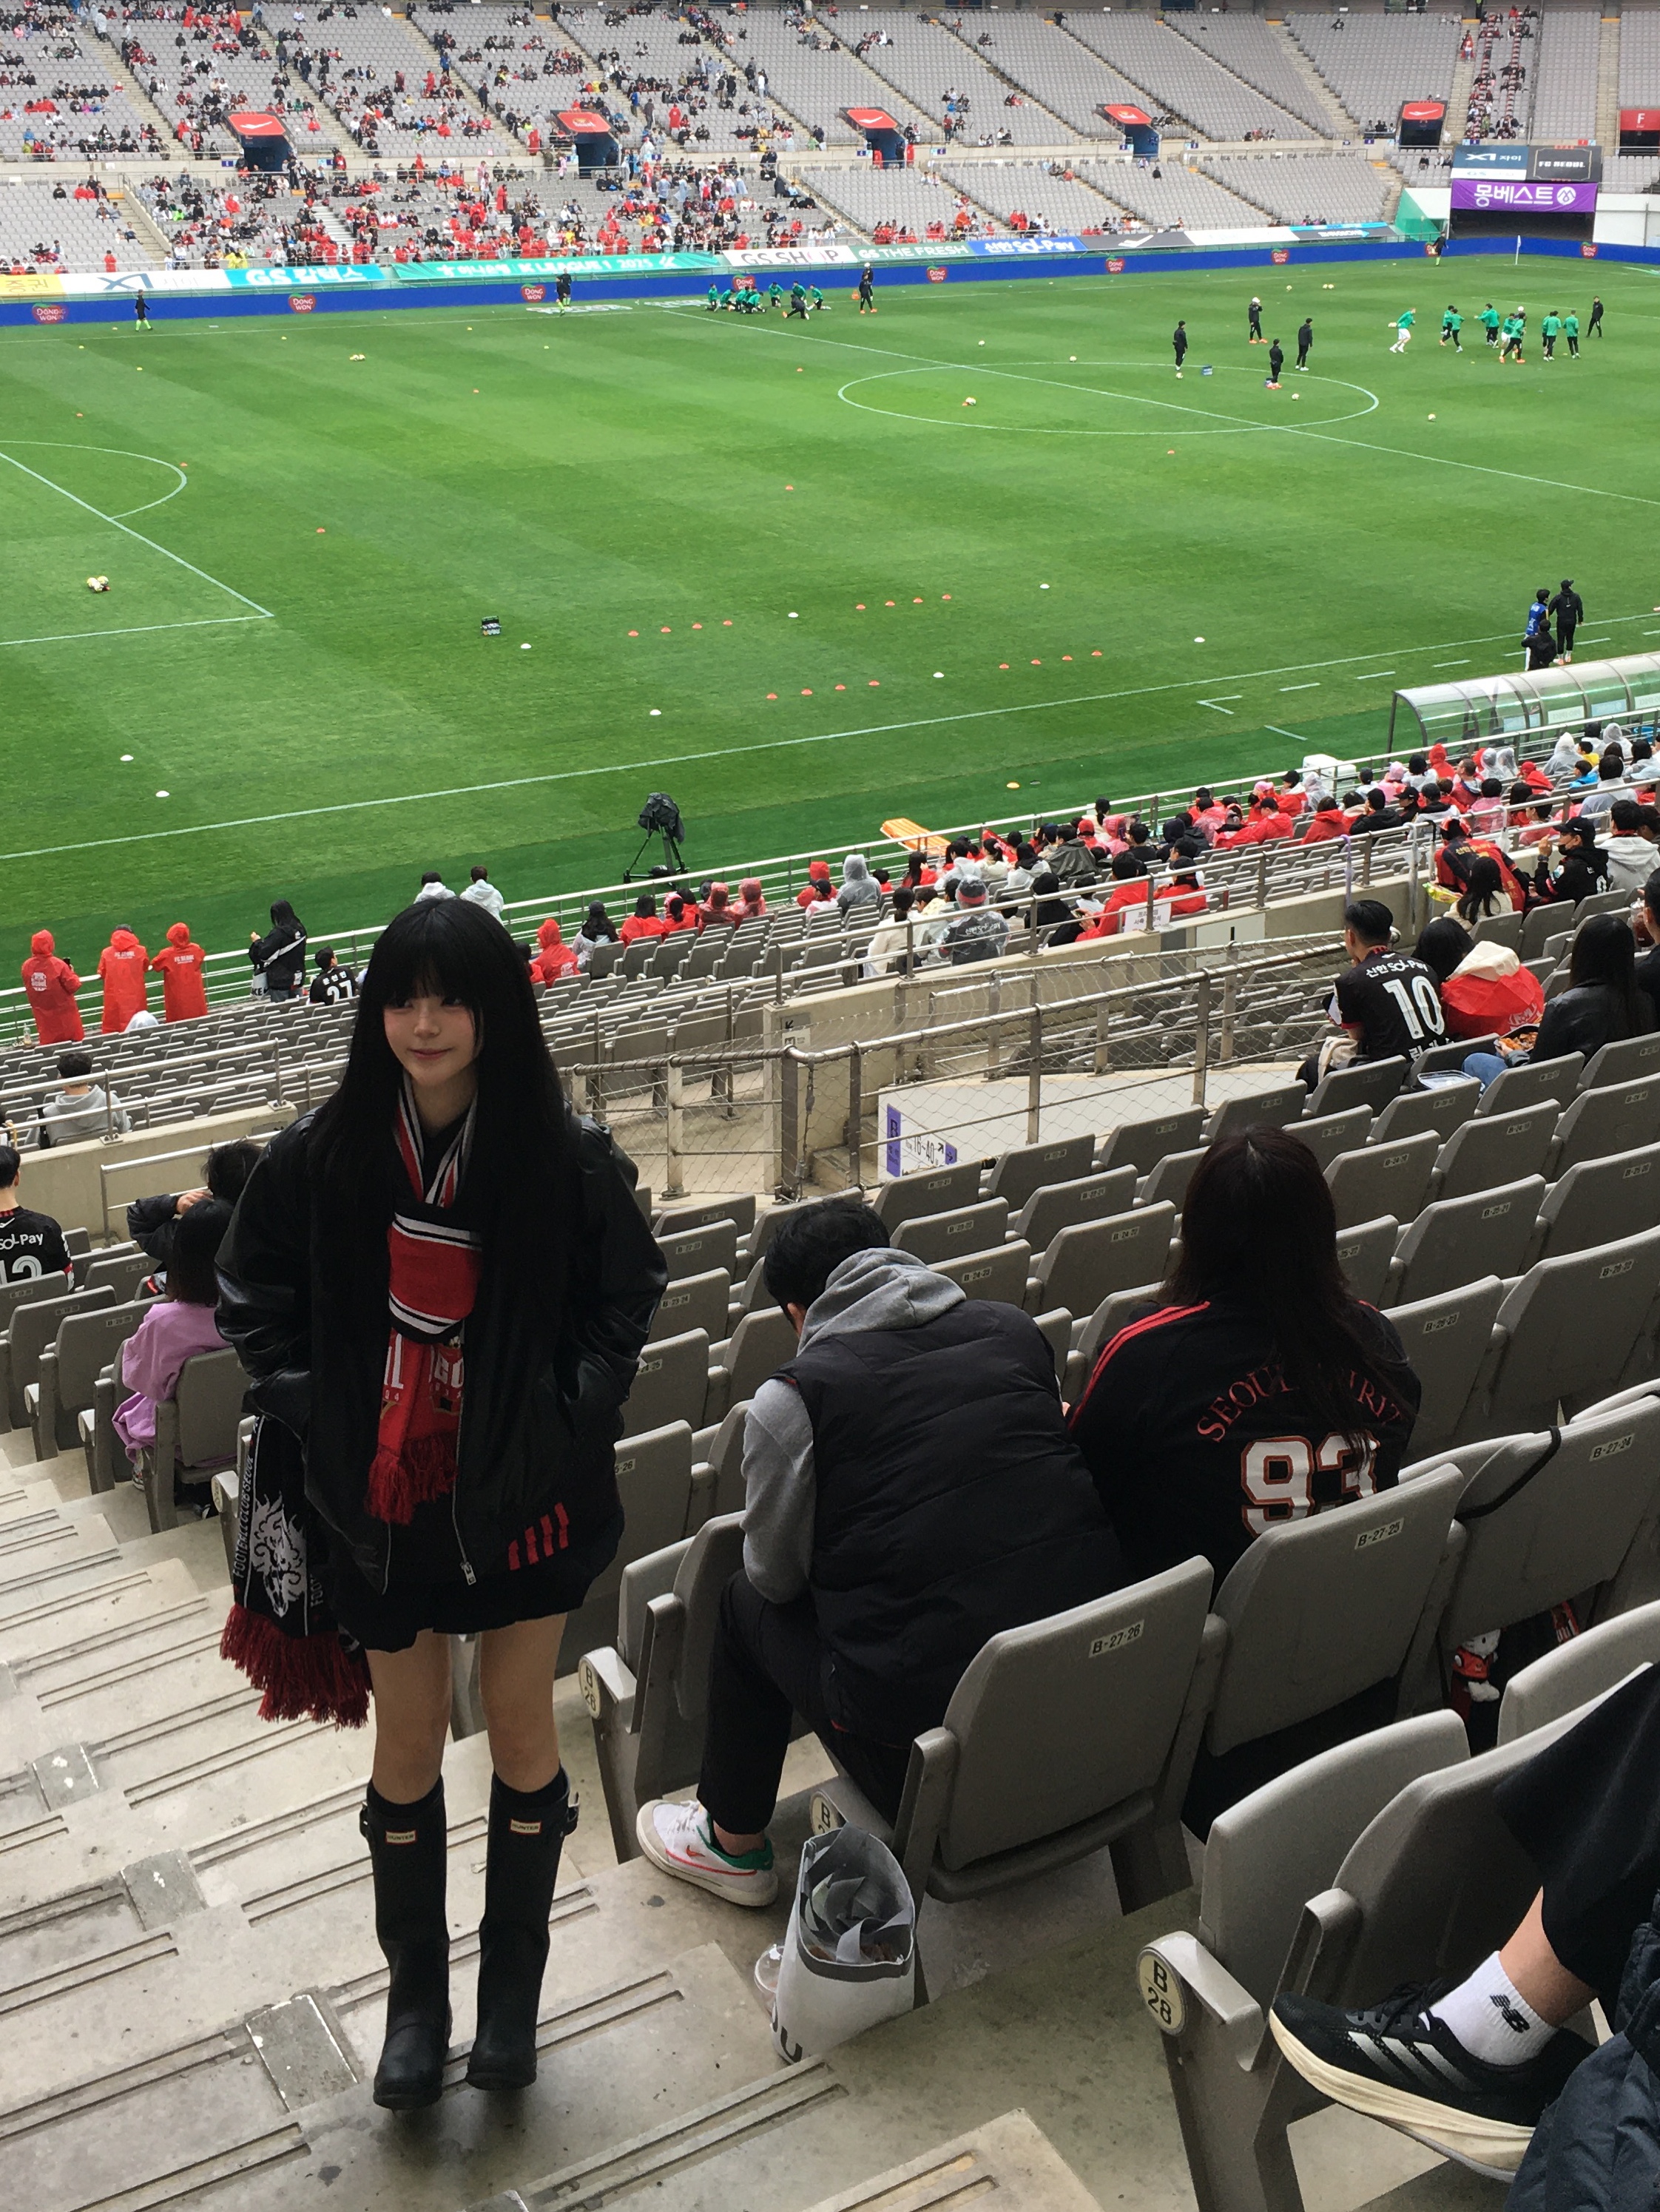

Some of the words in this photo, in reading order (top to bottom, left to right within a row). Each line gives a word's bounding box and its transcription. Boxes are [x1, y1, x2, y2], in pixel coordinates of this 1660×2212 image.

[1637, 112, 1645, 124] F
[1474, 184, 1553, 208] 몽베스트
[740, 252, 775, 266] GS
[775, 249, 840, 265] SHOP
[858, 249, 880, 260] GS
[879, 247, 914, 258] THE
[914, 245, 969, 257] FRESH
[5, 278, 49, 293] 증권
[246, 269, 292, 286] GS
[293, 266, 368, 283] 칼텍스
[293, 297, 314, 306] DONG
[1366, 964, 1389, 977] 신한
[1407, 960, 1428, 972] Pay
[327, 979, 353, 1005] 27
[1382, 975, 1445, 1039] 10
[890, 1118, 898, 1138] B
[19, 1233, 43, 1246] Pay
[1241, 1429, 1381, 1540] 93
[240, 1492, 251, 1524] CLUB
[232, 1525, 249, 1578] FOOTBALL
[585, 1665, 593, 1688] B
[821, 1801, 831, 1829] B
[1153, 1959, 1168, 1993] B
[1147, 1986, 1172, 2025] 28
